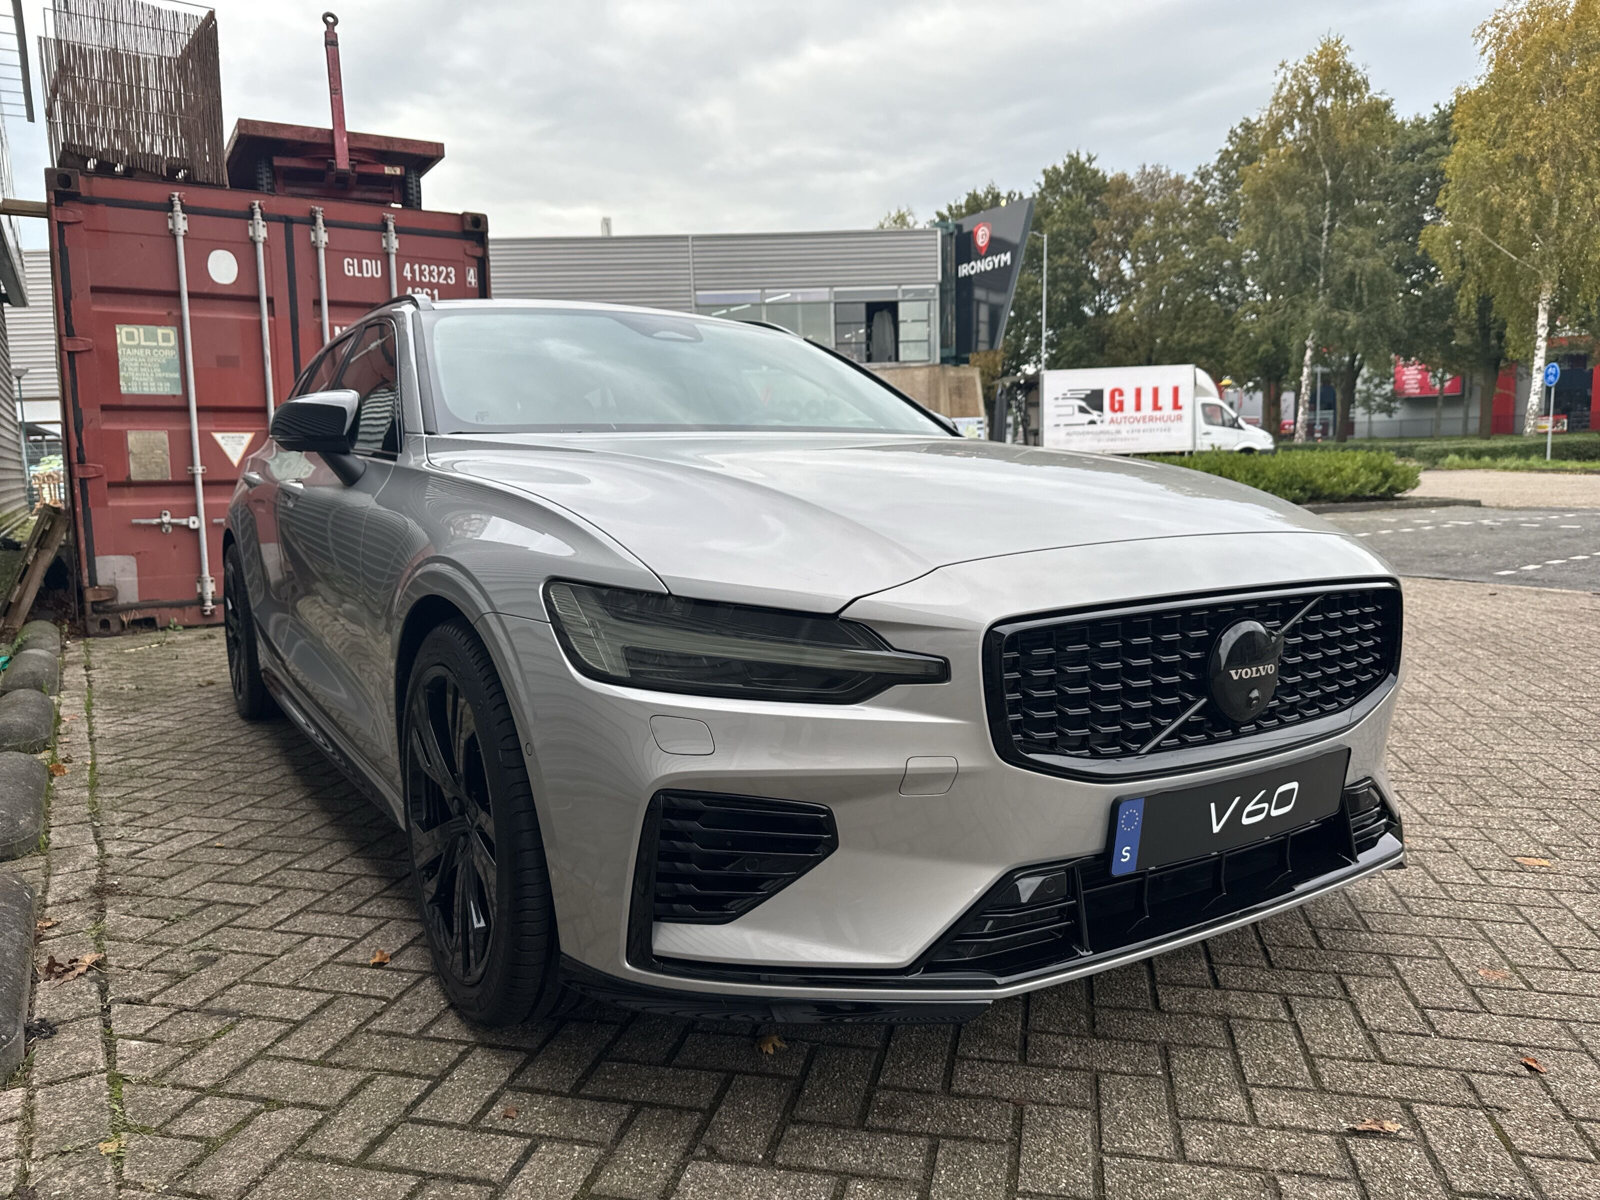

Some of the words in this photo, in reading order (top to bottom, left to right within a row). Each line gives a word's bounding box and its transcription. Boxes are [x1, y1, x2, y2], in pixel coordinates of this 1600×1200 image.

[344, 257, 382, 278] GLDU
[403, 263, 456, 285] 413323
[466, 267, 477, 287] 4
[957, 251, 1012, 278] IRONGYM
[1108, 385, 1183, 413] GILL
[1108, 413, 1183, 425] AUTOVERHUUR
[1229, 663, 1275, 680] VOLVO
[1120, 846, 1132, 862] S
